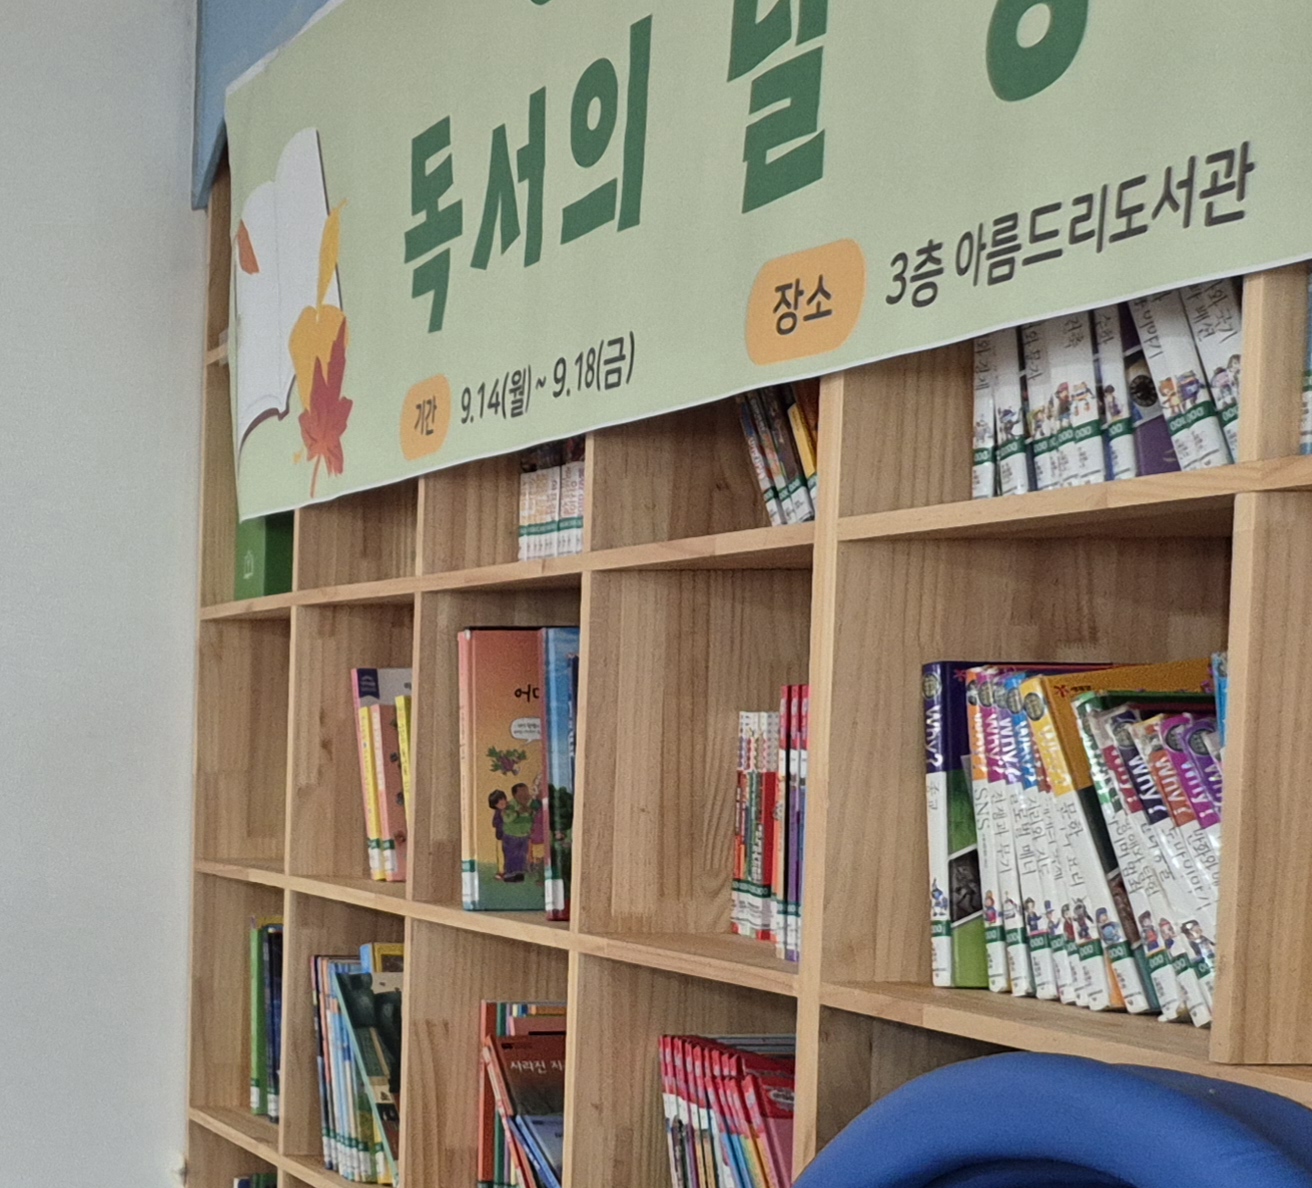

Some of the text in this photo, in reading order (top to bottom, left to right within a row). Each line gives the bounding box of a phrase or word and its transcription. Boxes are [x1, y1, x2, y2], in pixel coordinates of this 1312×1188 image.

[404, 14, 654, 334] 독서의
[885, 141, 1256, 308] 3층 아름드리도서관
[772, 274, 833, 336] 장소
[460, 366, 533, 425] 9.14(월)
[552, 331, 636, 398] 9.18(금)
[413, 399, 437, 437] 기간
[926, 705, 944, 768] Why?
[975, 787, 991, 832] SNS
